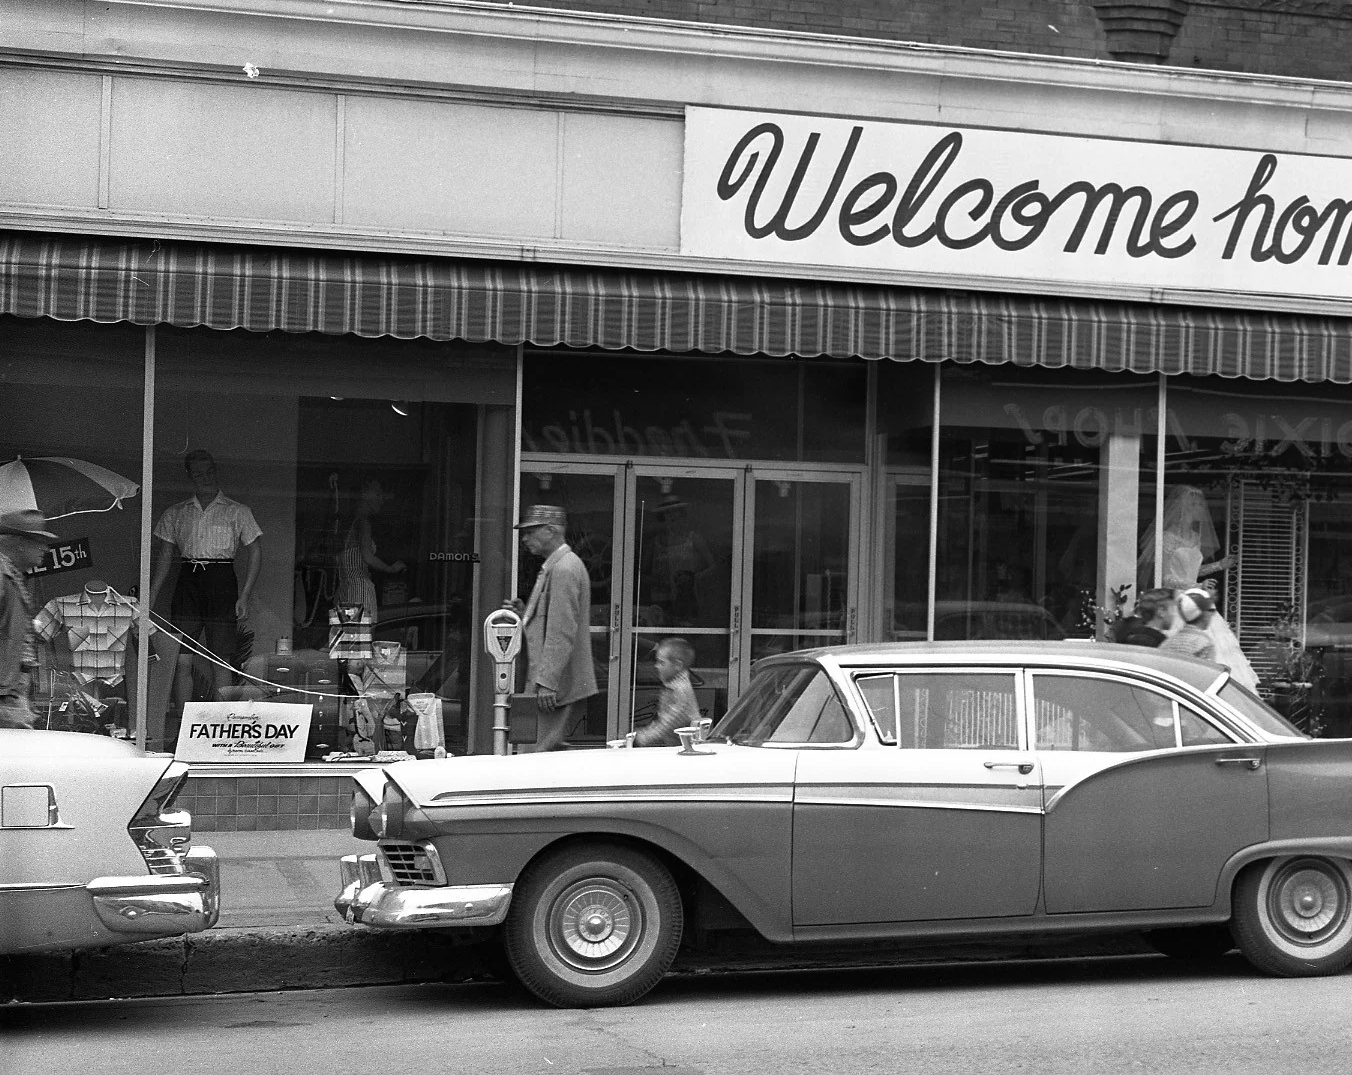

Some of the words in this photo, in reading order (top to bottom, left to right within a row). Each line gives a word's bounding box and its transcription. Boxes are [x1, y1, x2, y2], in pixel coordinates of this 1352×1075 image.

[717, 122, 1199, 260] Welcome
[49, 544, 87, 569] 15th
[429, 552, 479, 562] DAMON'S
[189, 720, 262, 739] FATHER'S
[264, 724, 299, 739] DAY
